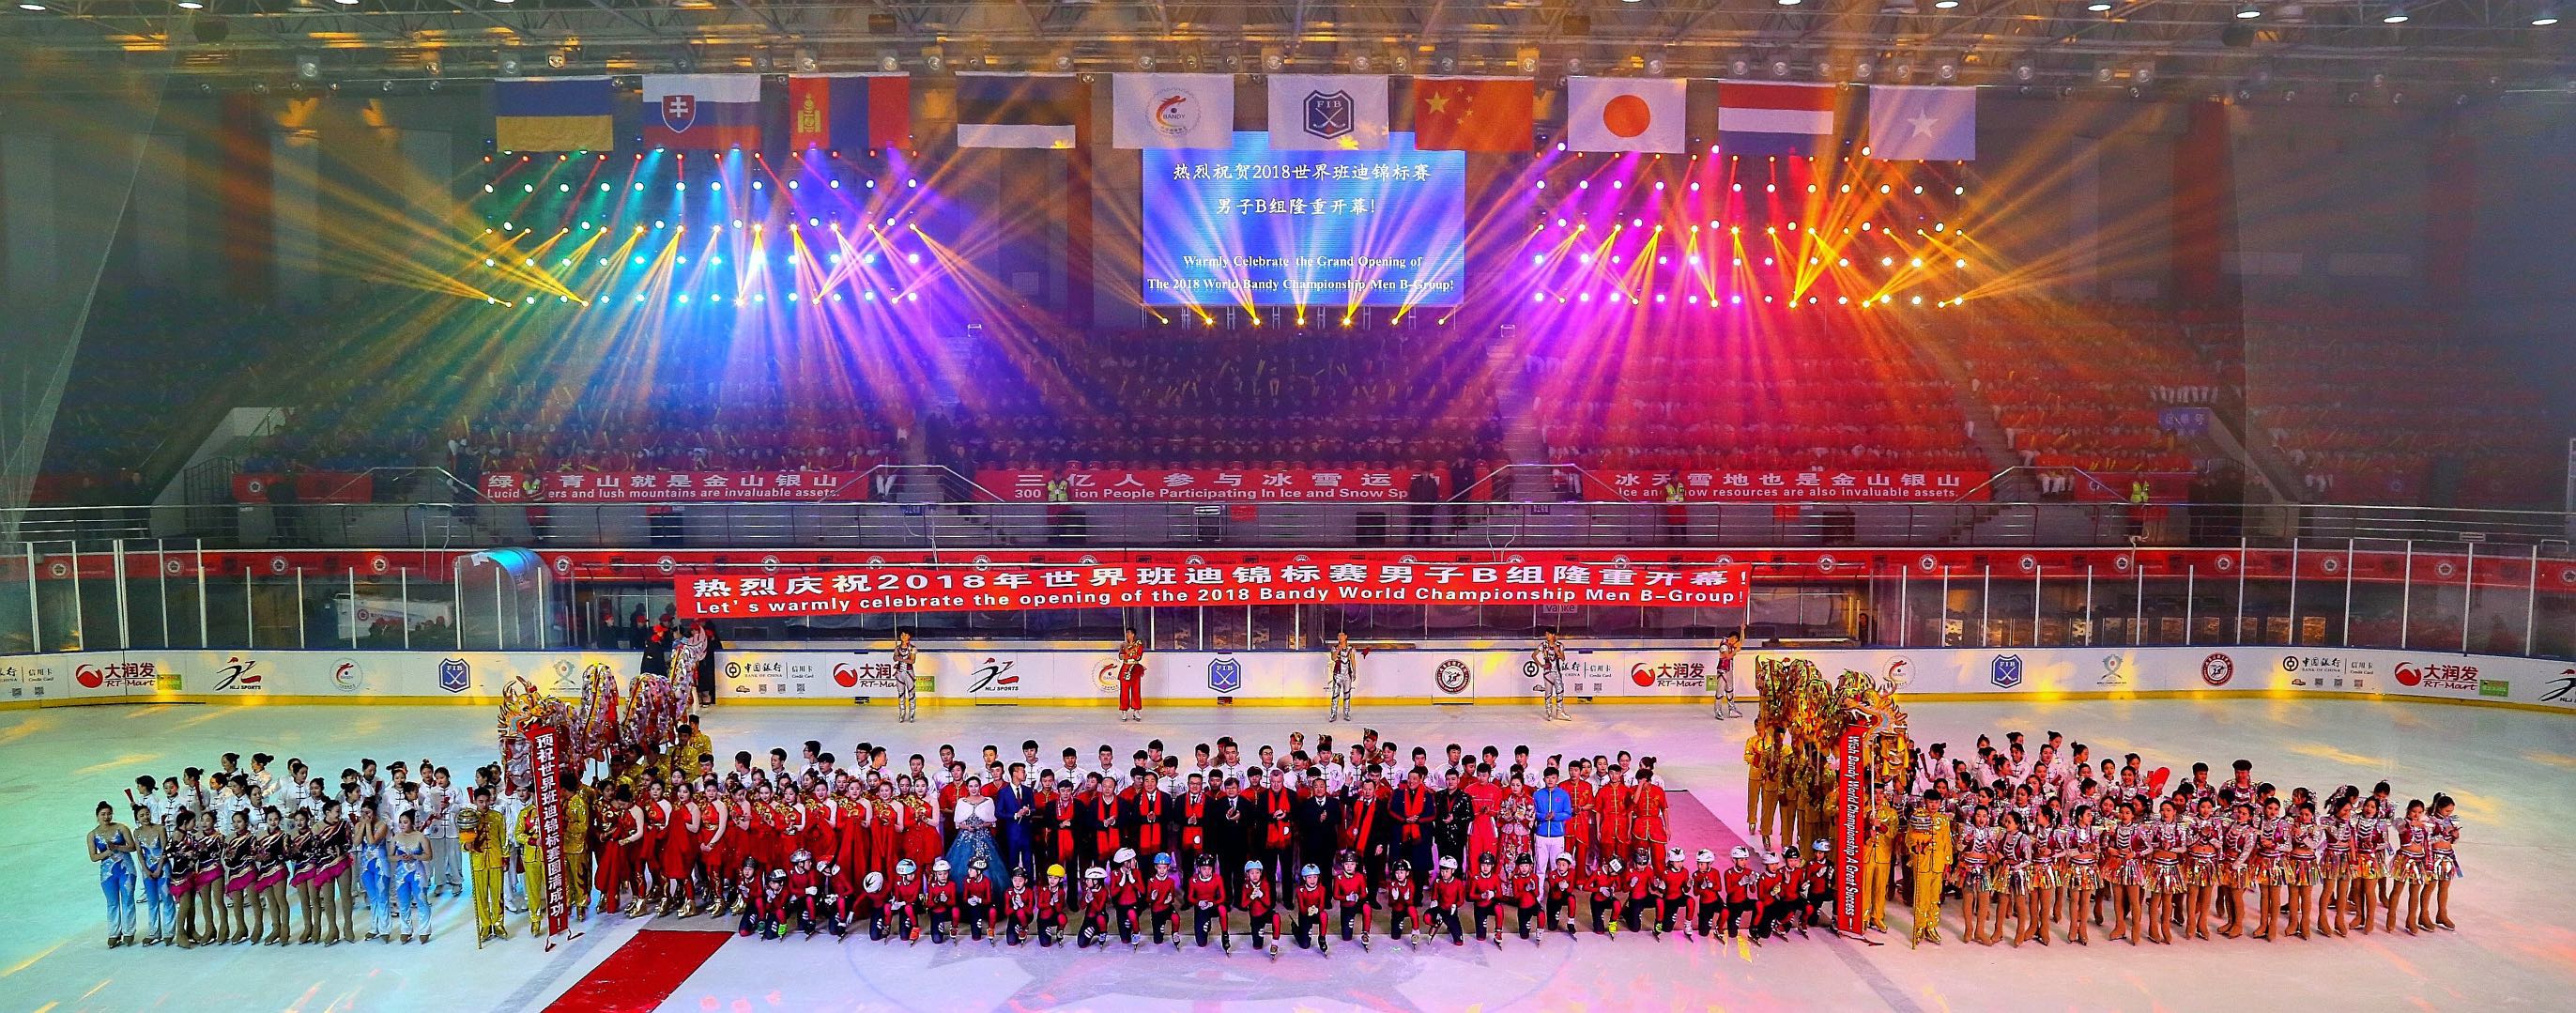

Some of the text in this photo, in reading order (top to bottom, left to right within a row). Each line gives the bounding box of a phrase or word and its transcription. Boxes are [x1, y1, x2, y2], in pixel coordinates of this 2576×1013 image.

[1173, 162, 1432, 182] 热烈祝贺2018世界班迪锦标赛
[1184, 255, 1423, 269] Warmly Celebrate the Grand Opening of
[1147, 278, 1454, 292] The 2018 World Bandy Championship Men B-Group!
[487, 474, 836, 488] 绿青山就是金山银山
[487, 488, 520, 499] Lucid
[571, 489, 595, 499] and
[599, 489, 625, 499] lush
[629, 488, 697, 499] mountains
[700, 489, 720, 498] are
[725, 487, 791, 498] invaluable
[795, 488, 839, 497] assets.
[1014, 489, 1042, 499] 300
[1103, 488, 1146, 500] People
[1159, 488, 1257, 499] Participating
[1261, 488, 1275, 498] In
[1280, 488, 1301, 498] Ice
[1306, 488, 1335, 498] and
[1339, 488, 1384, 498] Snow
[1619, 487, 1638, 497] Ice
[1809, 487, 1836, 497] also
[1841, 487, 1909, 497] invaluable
[1914, 488, 1958, 498] assets.
[693, 563, 1747, 598] 热烈庆祝2018年世界班迪锦标赛男子B组隆重开幕!
[768, 597, 851, 612] warmly
[859, 595, 964, 609] celebrate
[974, 591, 1010, 606] the
[1020, 591, 1111, 607] opening
[1121, 589, 1142, 603] of
[1151, 589, 1188, 603] the
[1197, 588, 1250, 601] 2018
[1260, 586, 1329, 602] Bandy
[1339, 586, 1406, 600] World
[1416, 586, 1576, 603] Championship
[1586, 589, 1637, 602] Men
[744, 662, 782, 673] 中国银行
[2302, 656, 2341, 668] 中国银行
[104, 662, 156, 679] 大润发
[1657, 662, 1705, 679] 大润发
[2423, 664, 2478, 682] 大润发
[104, 679, 156, 687] RT-Mart
[860, 680, 897, 688] RT-Ma
[2423, 680, 2478, 691] RT-Mart
[1848, 735, 1860, 754] Wish
[1844, 755, 1860, 780] Bandy
[1847, 780, 1860, 804] World
[1843, 804, 1860, 856] Championship
[1846, 865, 1859, 886] Great
